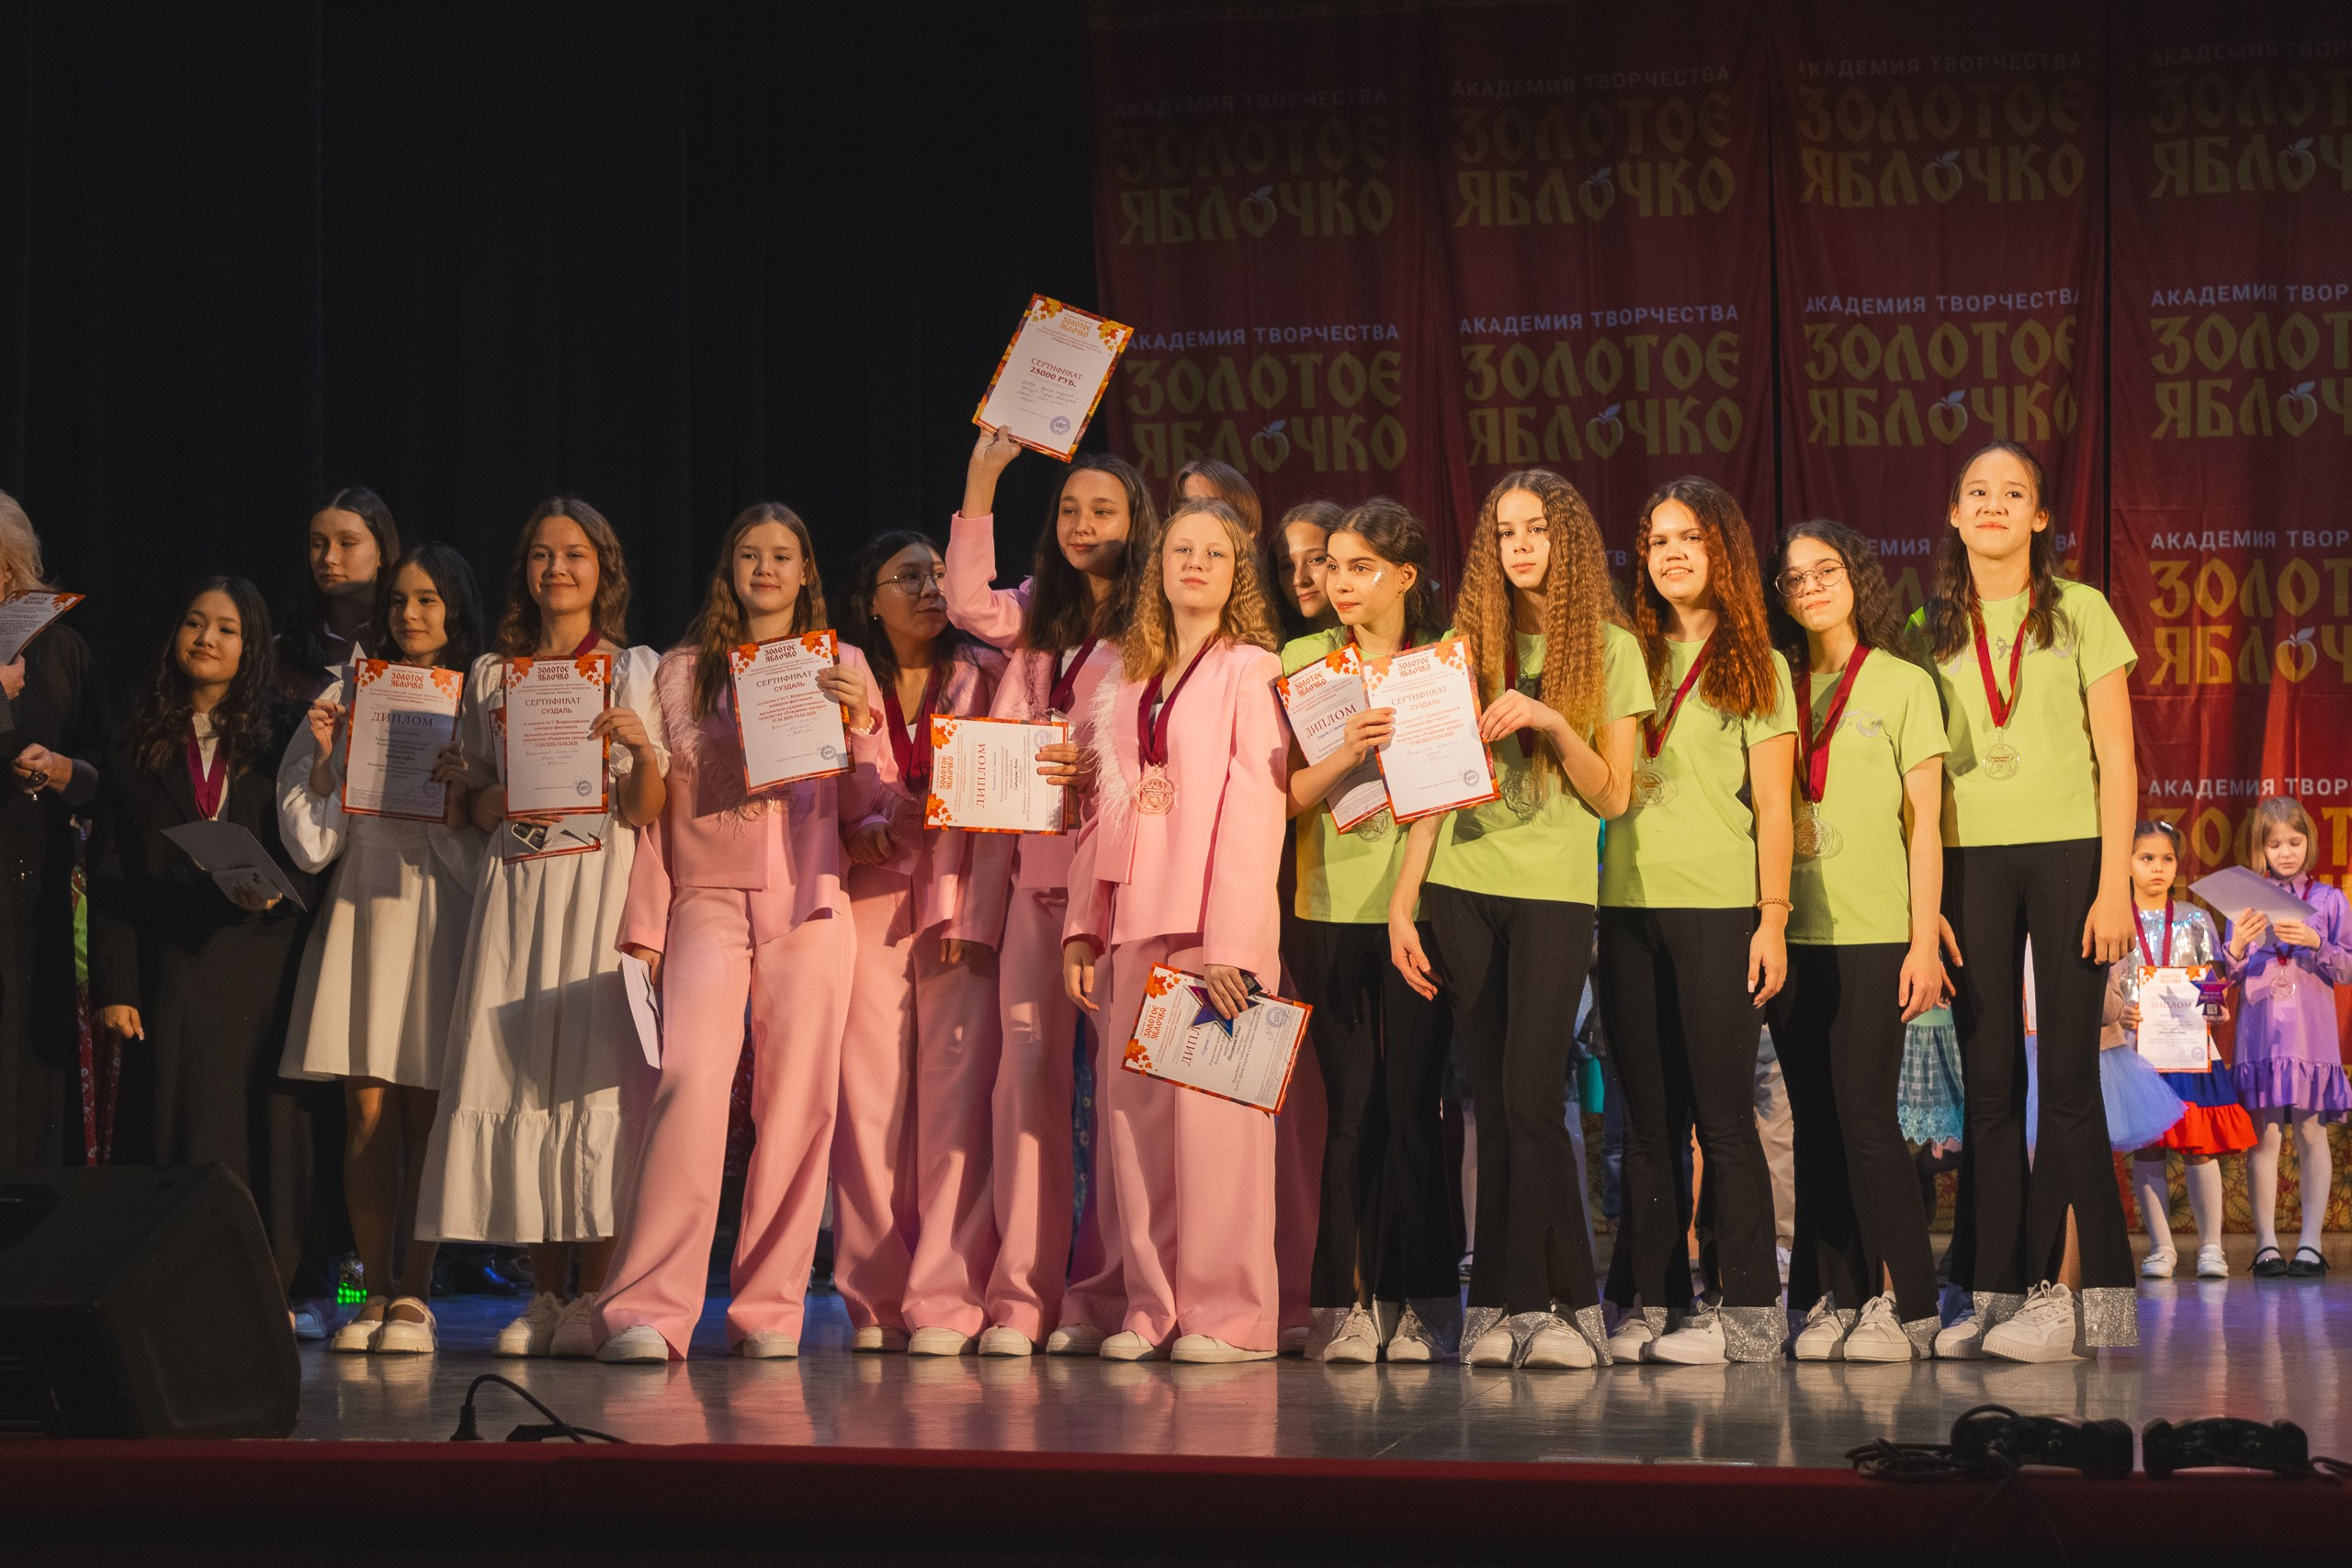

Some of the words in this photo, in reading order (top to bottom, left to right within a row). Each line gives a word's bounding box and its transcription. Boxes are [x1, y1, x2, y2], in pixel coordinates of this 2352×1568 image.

[1798, 57, 1920, 78] АКАДЕМИЯ
[1929, 52, 2082, 73] ТВОРЧЕСТВА
[1450, 76, 1575, 99] АКАДЕМИЯ
[1584, 65, 1730, 92] ТВОРЧЕСТВА
[1114, 96, 1235, 118] АКАДЕМИЯ
[1240, 89, 1387, 109] ТВОРЧЕСТВА
[1796, 79, 2082, 143] ЗОЛОТОЕ
[1450, 90, 1732, 164] ЗОЛОТОЕ
[1114, 115, 1389, 184] ЗОЛОТОЕ
[1801, 142, 2084, 209] ЯБЛОЧКО
[1453, 154, 1736, 228] ЯБЛОЧКО
[1118, 177, 1395, 245] ЯБЛОЧКО
[1804, 295, 1926, 316] АКАДЕМИЯ
[2151, 284, 2278, 307] АКАДЕМИЯ
[1058, 322, 1090, 338] ЯБЛОЧКО
[1061, 316, 1092, 332] ЗОЛОТОЕ
[1253, 323, 1399, 343] ТВОРЧЕСТВА
[1460, 313, 1583, 336] АКАДЕМИЯ
[1590, 304, 1738, 328] ТВОРЧЕСТВА
[1804, 315, 2076, 382] ЗОЛОТОЕ
[1030, 356, 1083, 382] СЕРТИФИКАТ
[1030, 366, 1057, 381] 25000
[1057, 376, 1078, 388] РУБ.
[1461, 331, 1739, 400] ЗОЛОТОЕ
[1125, 350, 1401, 415] ЗОЛОТОЕ
[1807, 380, 2077, 447] ЯБЛОЧКО
[1467, 393, 1743, 467] ЯБЛОЧКО
[1132, 412, 1407, 479] ЯБЛОЧКО
[2150, 530, 2277, 552] АКАДЕМИЯ
[764, 644, 796, 656] ЗОЛОТОЕ
[765, 650, 797, 662] ЯБЛОЧКО
[1397, 656, 1430, 671] ЗОЛОТОЕ
[1399, 663, 1431, 678] ЯБЛОЧКО
[390, 680, 424, 690] ЯБЛОЧКО
[391, 672, 424, 682] ЗОЛОТОЕ
[756, 671, 813, 688] СЕРТИФИКАТ
[774, 681, 805, 693] СУЗДАЛЬ
[1294, 671, 1324, 691] ЗОЛОТОЕ
[1297, 677, 1327, 698] ЯБЛОЧКО
[526, 697, 581, 706] СЕРТИФИКАТ
[1391, 685, 1448, 706] СЕРТИФИКАТ
[1409, 697, 1442, 712] СУЗДАЛЬ
[371, 711, 434, 728] ДИПЛОМ
[1304, 703, 1358, 739] ДИПЛОМ
[945, 756, 954, 790] ЯБЛОЧКО
[975, 743, 987, 808] ДИПЛОМ
[2149, 780, 2275, 803] АКАДЕМИЯ
[1143, 1004, 1159, 1038] ЗОЛОТОЕ
[1150, 1007, 1167, 1041] ЯБЛОЧКО
[1181, 1025, 1202, 1066] ДИПЛ
